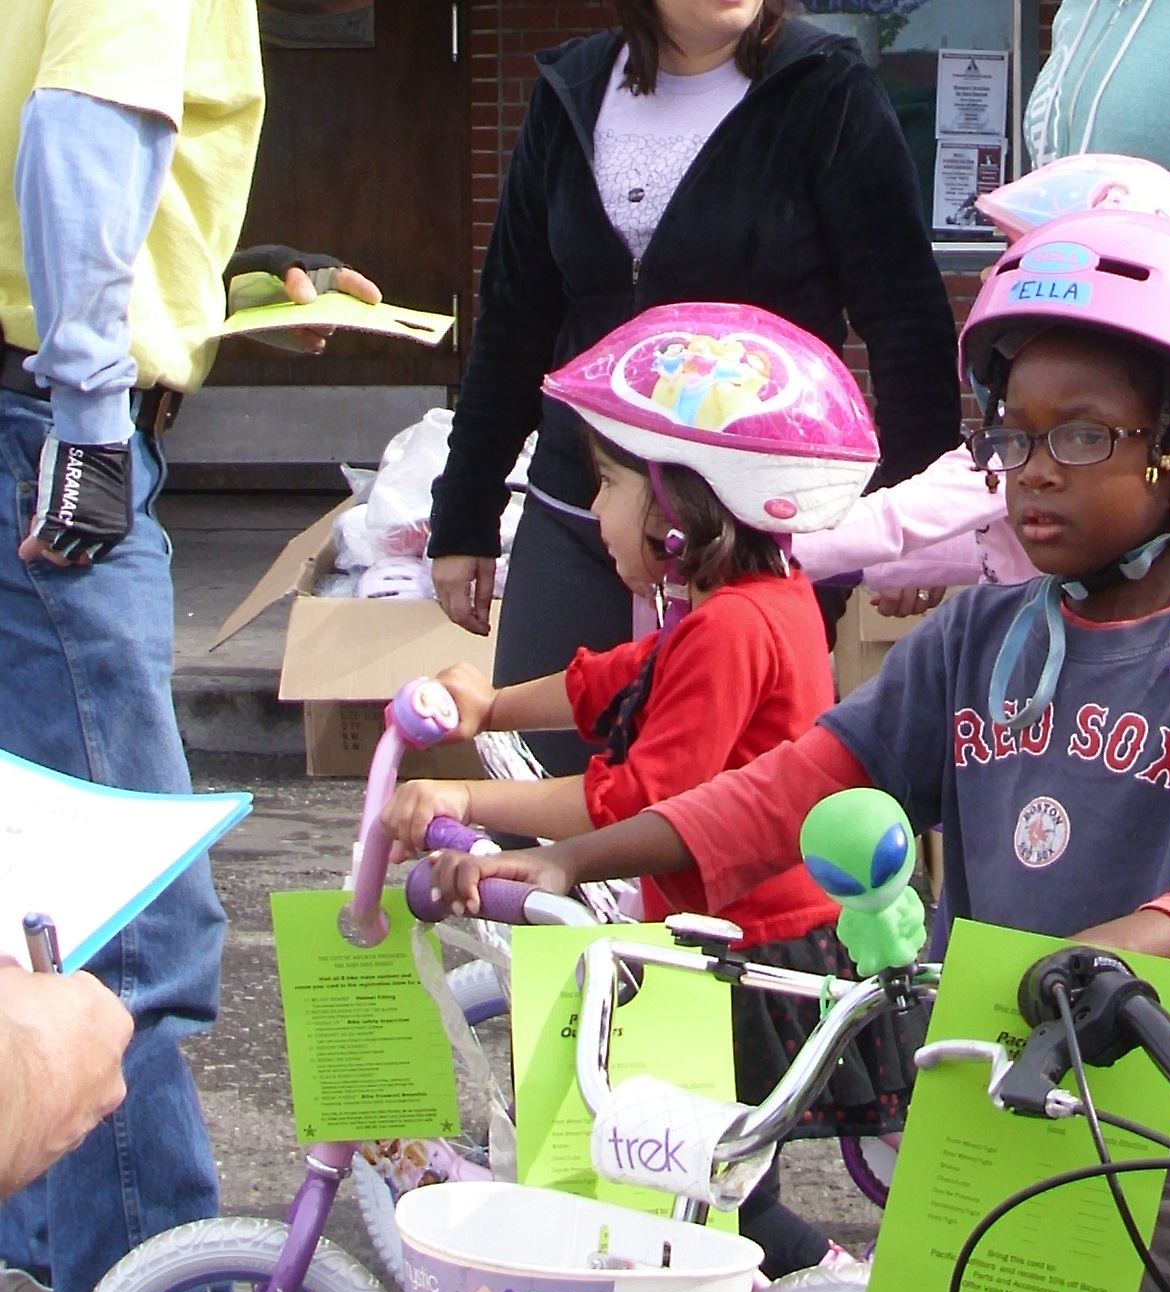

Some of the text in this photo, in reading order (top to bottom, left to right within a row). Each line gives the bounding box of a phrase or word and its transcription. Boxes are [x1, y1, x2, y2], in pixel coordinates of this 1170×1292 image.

[1018, 280, 1078, 300] ELLA
[58, 447, 84, 527] SARANAC
[954, 698, 1054, 767] RED
[1022, 803, 1063, 826] BOSTON
[607, 1126, 689, 1174] trek
